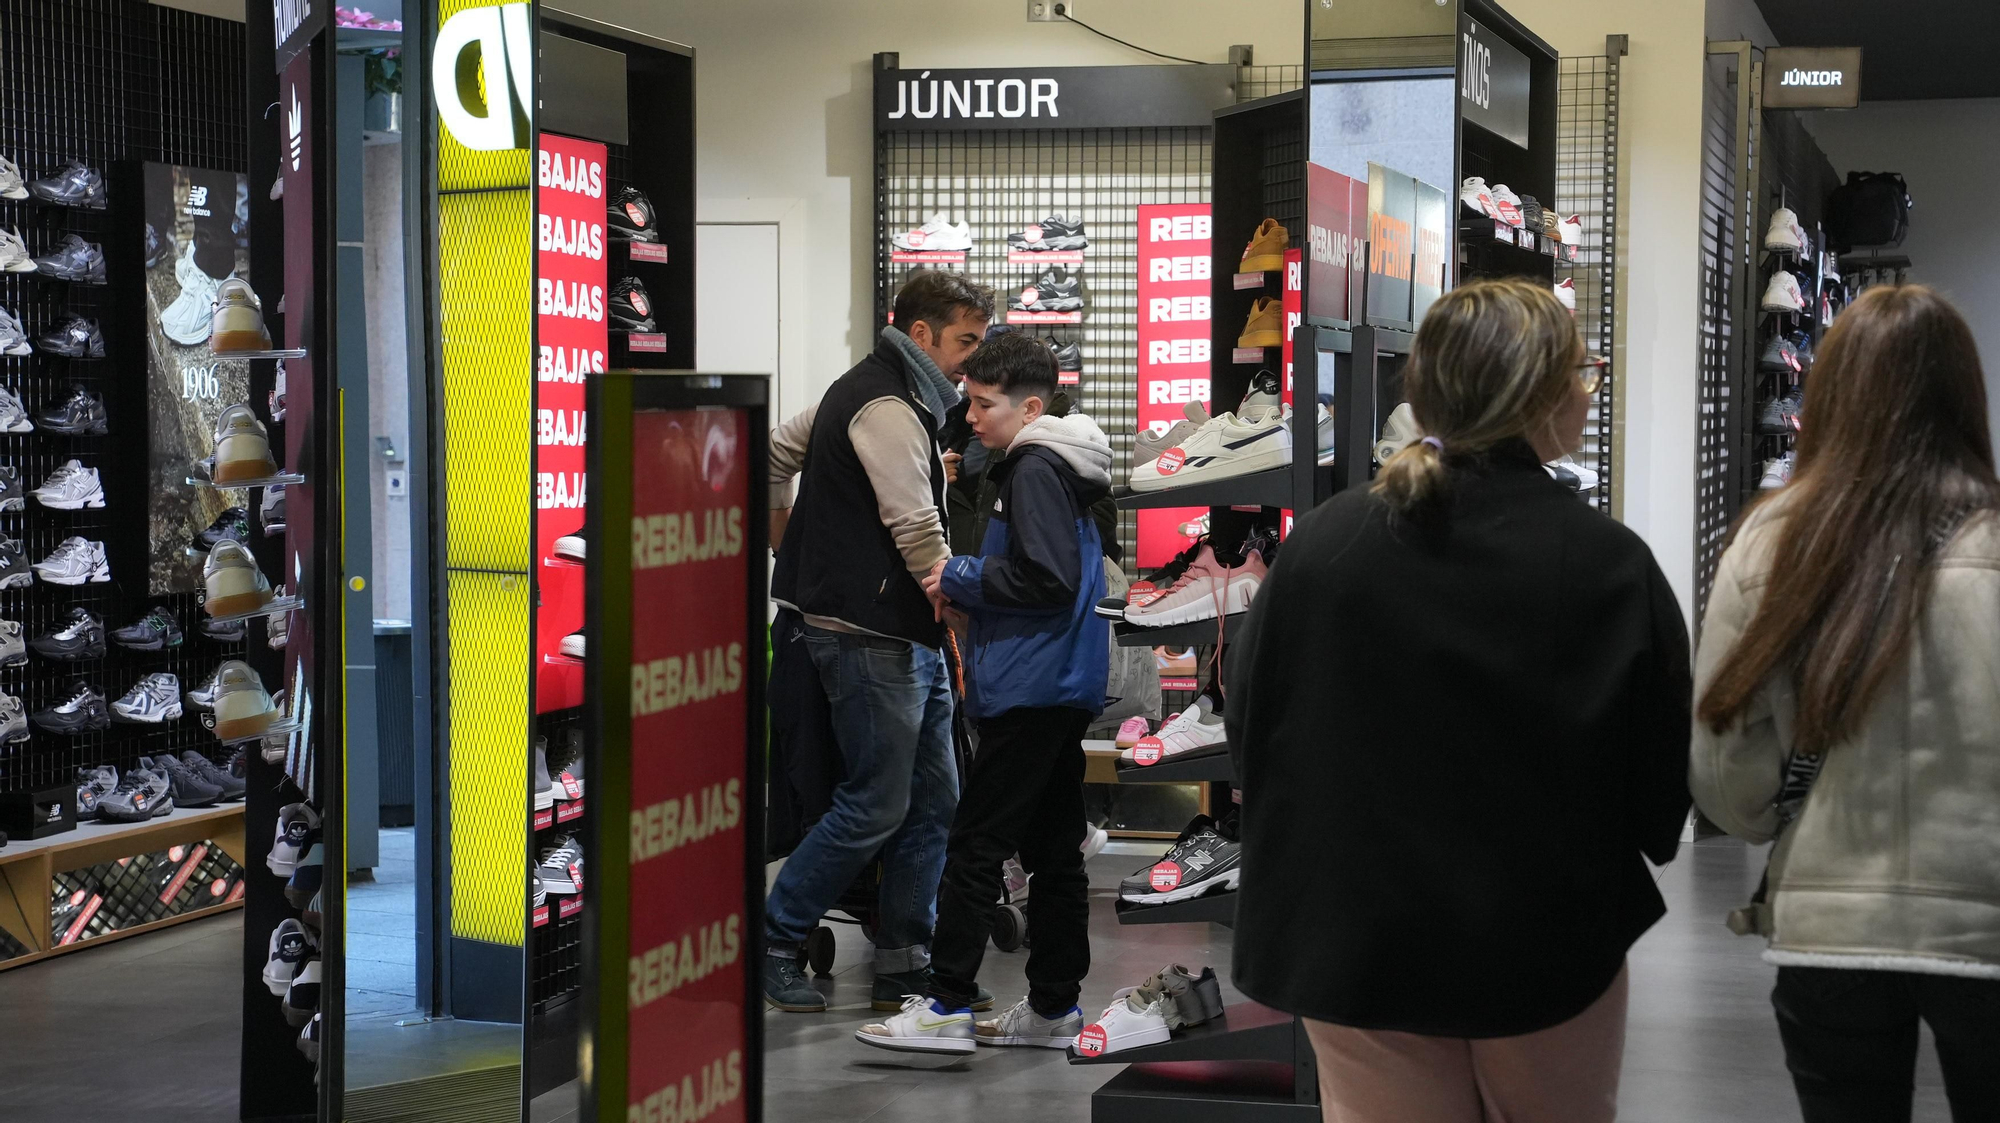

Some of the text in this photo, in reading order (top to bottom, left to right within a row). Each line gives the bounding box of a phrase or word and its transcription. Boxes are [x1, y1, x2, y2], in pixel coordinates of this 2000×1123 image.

[1462, 22, 1491, 110] IÑOS
[1780, 68, 1842, 86] JÚNIOR
[888, 71, 1059, 119] JÚNIOR
[539, 149, 602, 199] BAJAS
[539, 213, 603, 261] BAJAS
[1310, 224, 1347, 269] REBAJAS
[538, 278, 604, 323] BAJAS
[182, 364, 219, 402] 1906
[538, 345, 604, 384] BAJAS
[537, 408, 587, 447] BAJA
[537, 472, 587, 509] BAJA
[631, 505, 743, 570] REBAJAS
[631, 641, 743, 719] REBAJAS
[630, 776, 742, 865] REBAJAS
[629, 912, 741, 1010] REBAJAS
